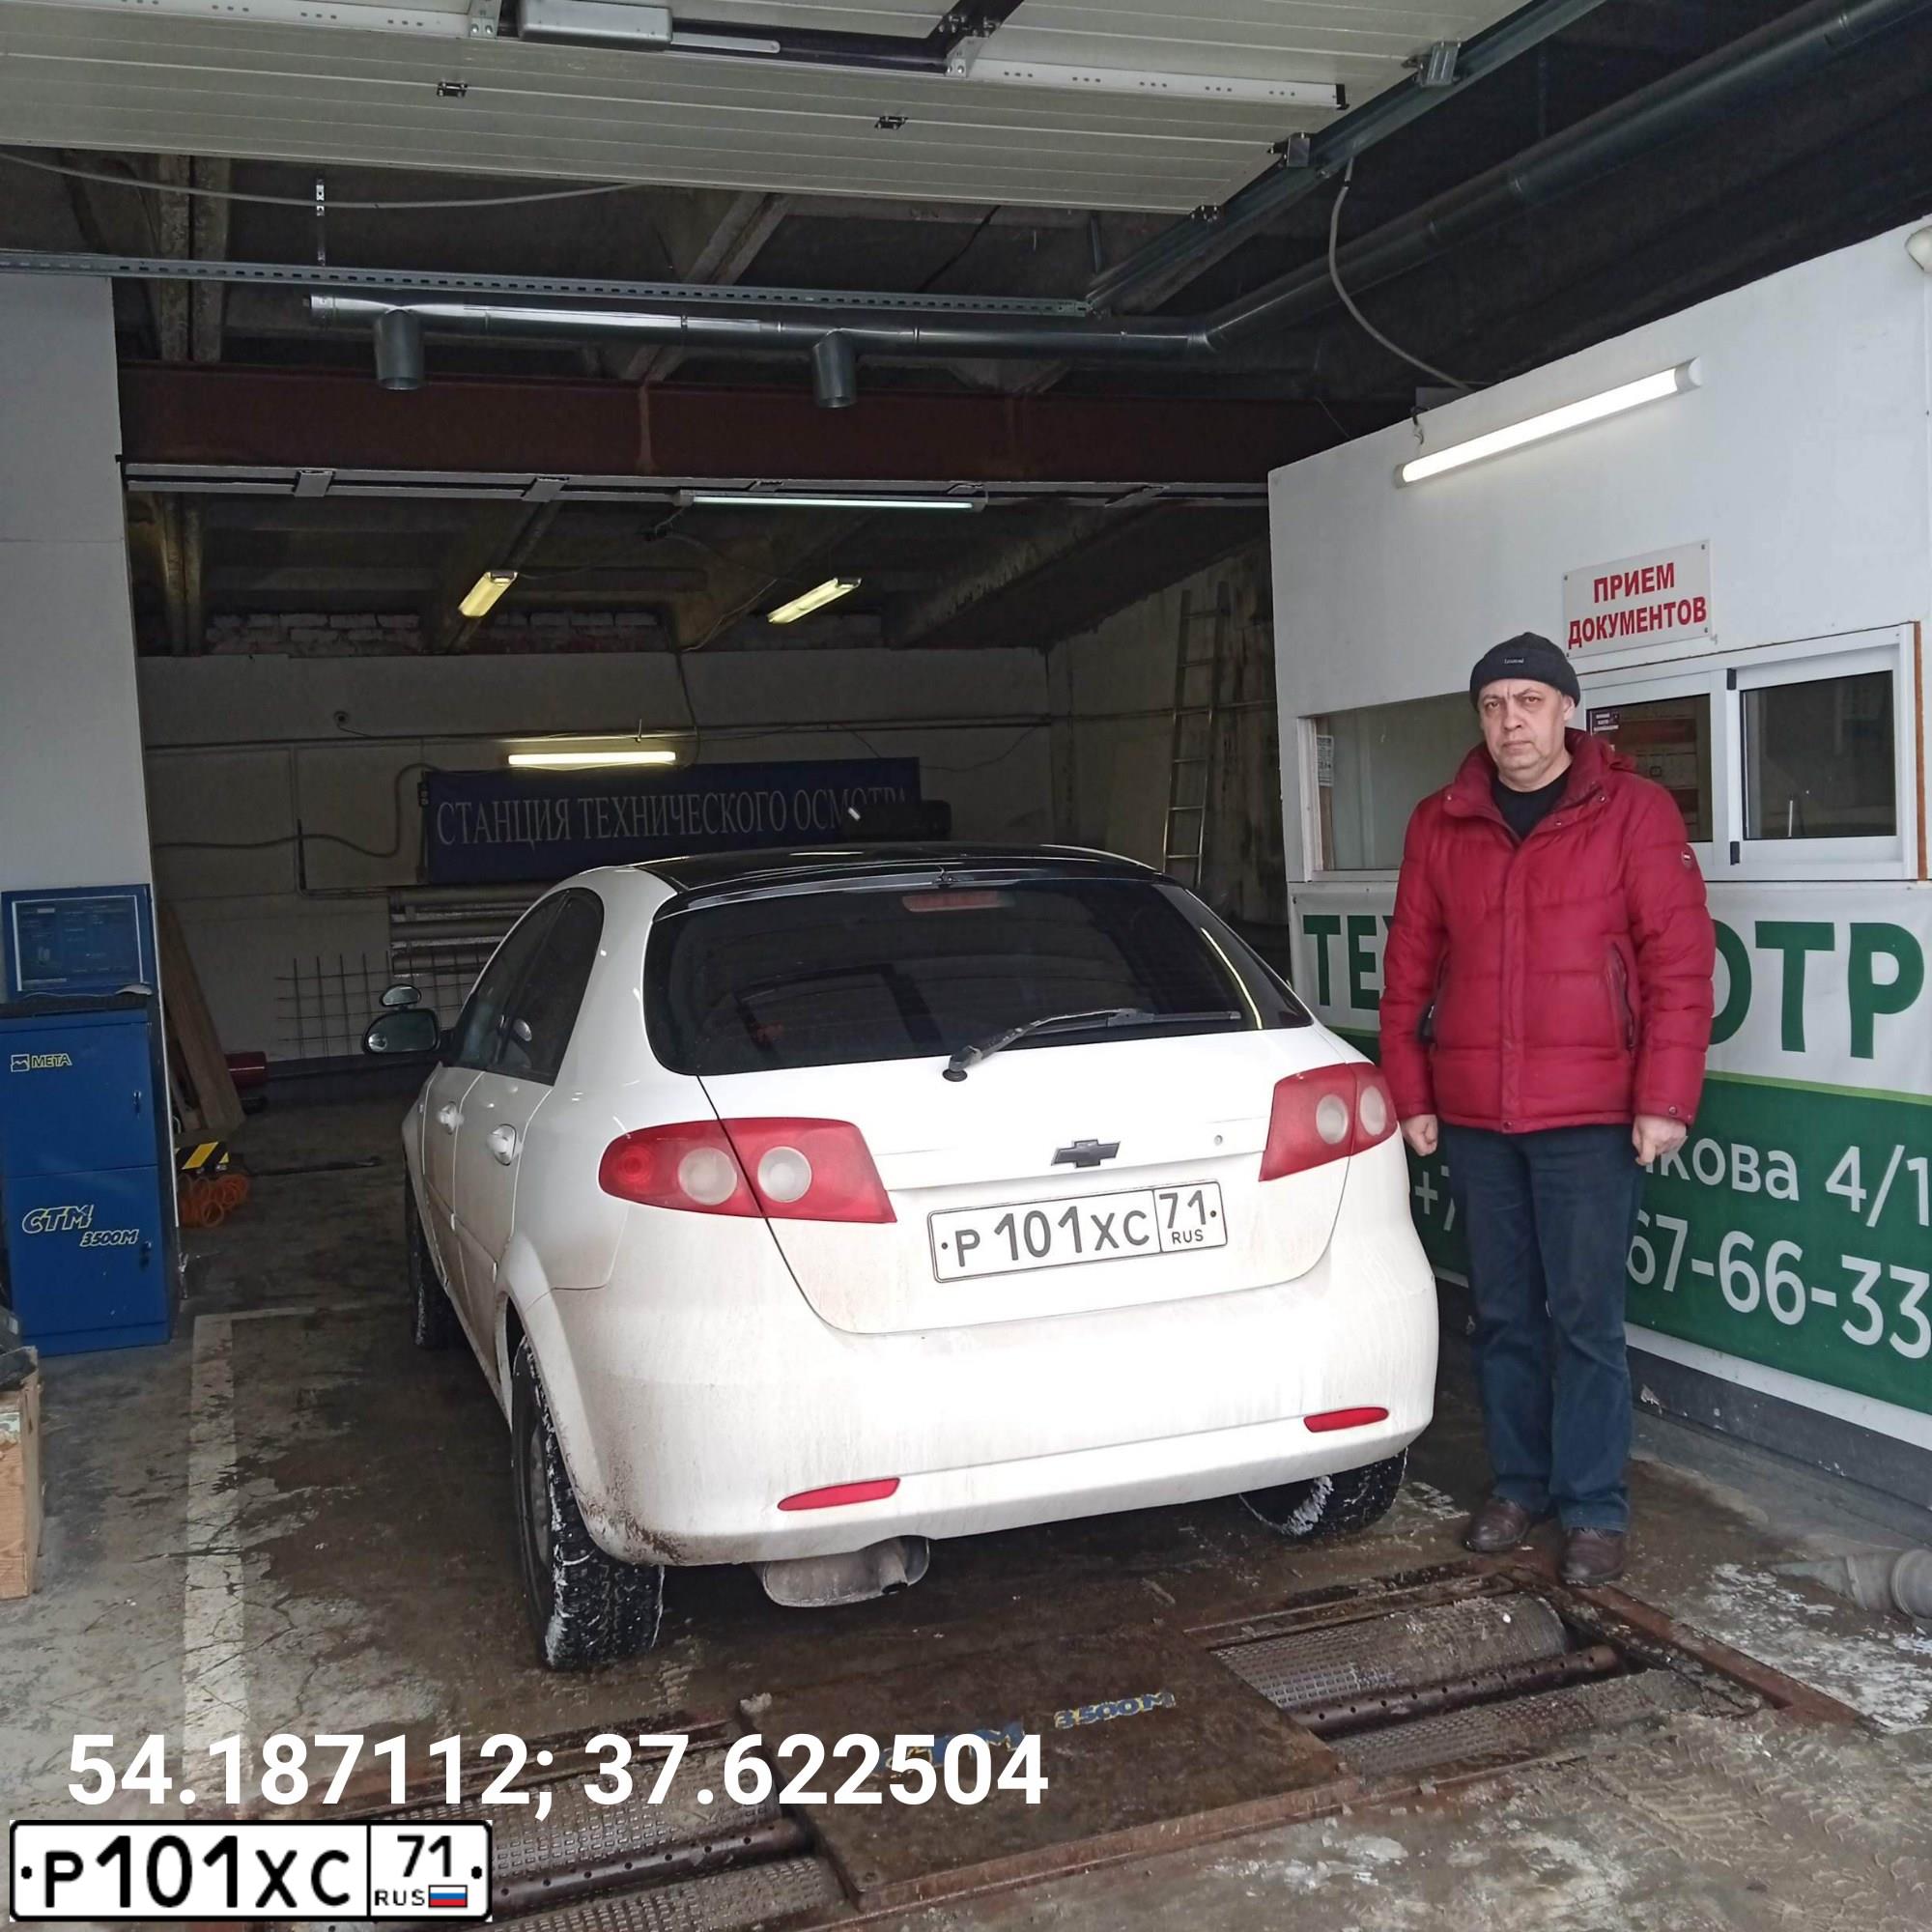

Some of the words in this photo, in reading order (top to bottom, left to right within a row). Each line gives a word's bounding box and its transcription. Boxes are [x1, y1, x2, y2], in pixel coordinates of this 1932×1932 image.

[1594, 562, 1675, 604] ПРИЕМ
[1568, 596, 1707, 650] ДОКУМЕНТОВ
[437, 798, 572, 851] СТАНЦИЯ
[577, 790, 787, 839] ТЕХНИЧЕСКОГО
[31, 1053, 73, 1068] МЕТА
[1825, 1144, 1930, 1228] 4/1
[79, 1229, 140, 1247] 3500М
[954, 1205, 1150, 1267] Р101ХС
[1158, 1189, 1207, 1229] 71
[1172, 1228, 1205, 1244] RUS
